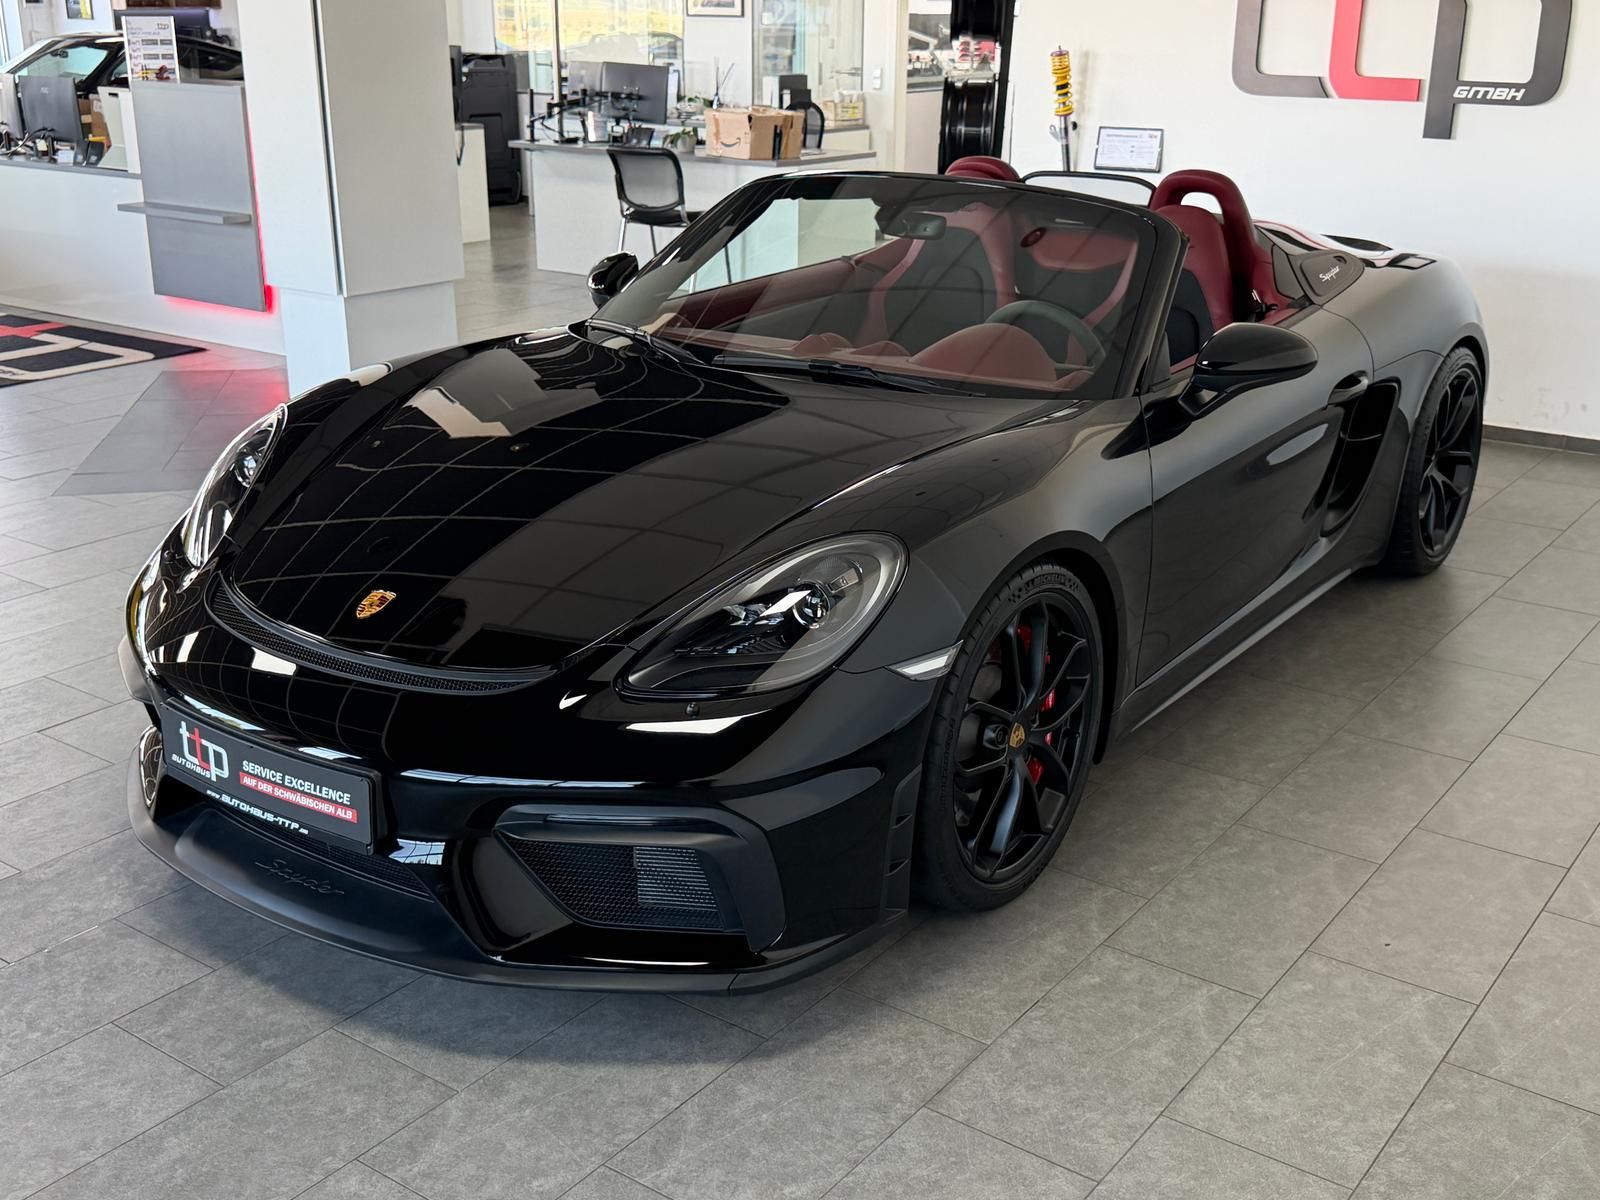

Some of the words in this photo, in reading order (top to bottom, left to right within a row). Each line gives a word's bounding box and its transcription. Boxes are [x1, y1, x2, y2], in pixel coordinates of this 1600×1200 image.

[179, 720, 229, 782] ttp
[242, 760, 283, 784] SERVICE
[284, 775, 351, 805] EXCELLENCE
[243, 776, 257, 788] AUF
[258, 781, 273, 794] DER
[274, 787, 335, 814] SCHWÄBISCHEN
[336, 809, 353, 820] ALB
